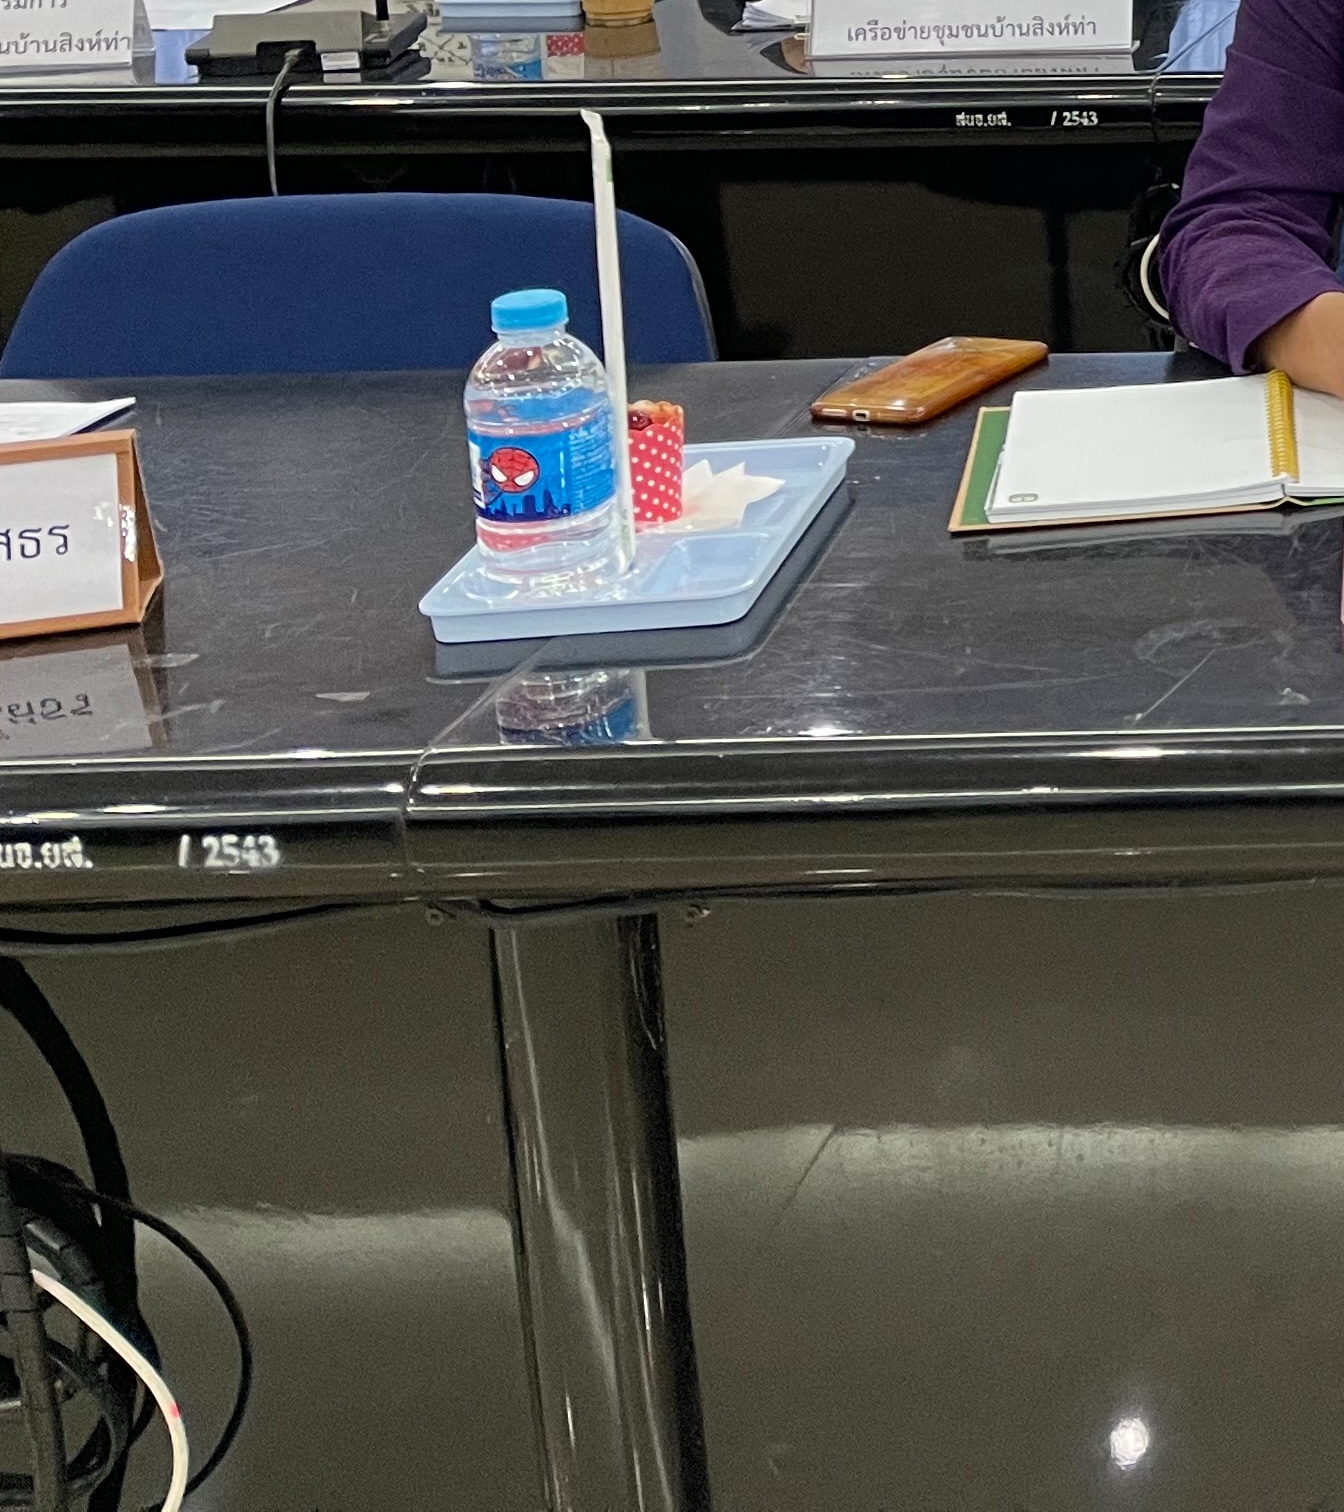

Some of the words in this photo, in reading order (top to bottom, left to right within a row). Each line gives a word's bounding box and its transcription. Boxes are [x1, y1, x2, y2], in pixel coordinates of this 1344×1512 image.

[847, 13, 1098, 46] เครือข่ายชุมชนบ้านสิงห์ท่า
[1062, 110, 1099, 127] 2543
[202, 834, 281, 868] 2543
